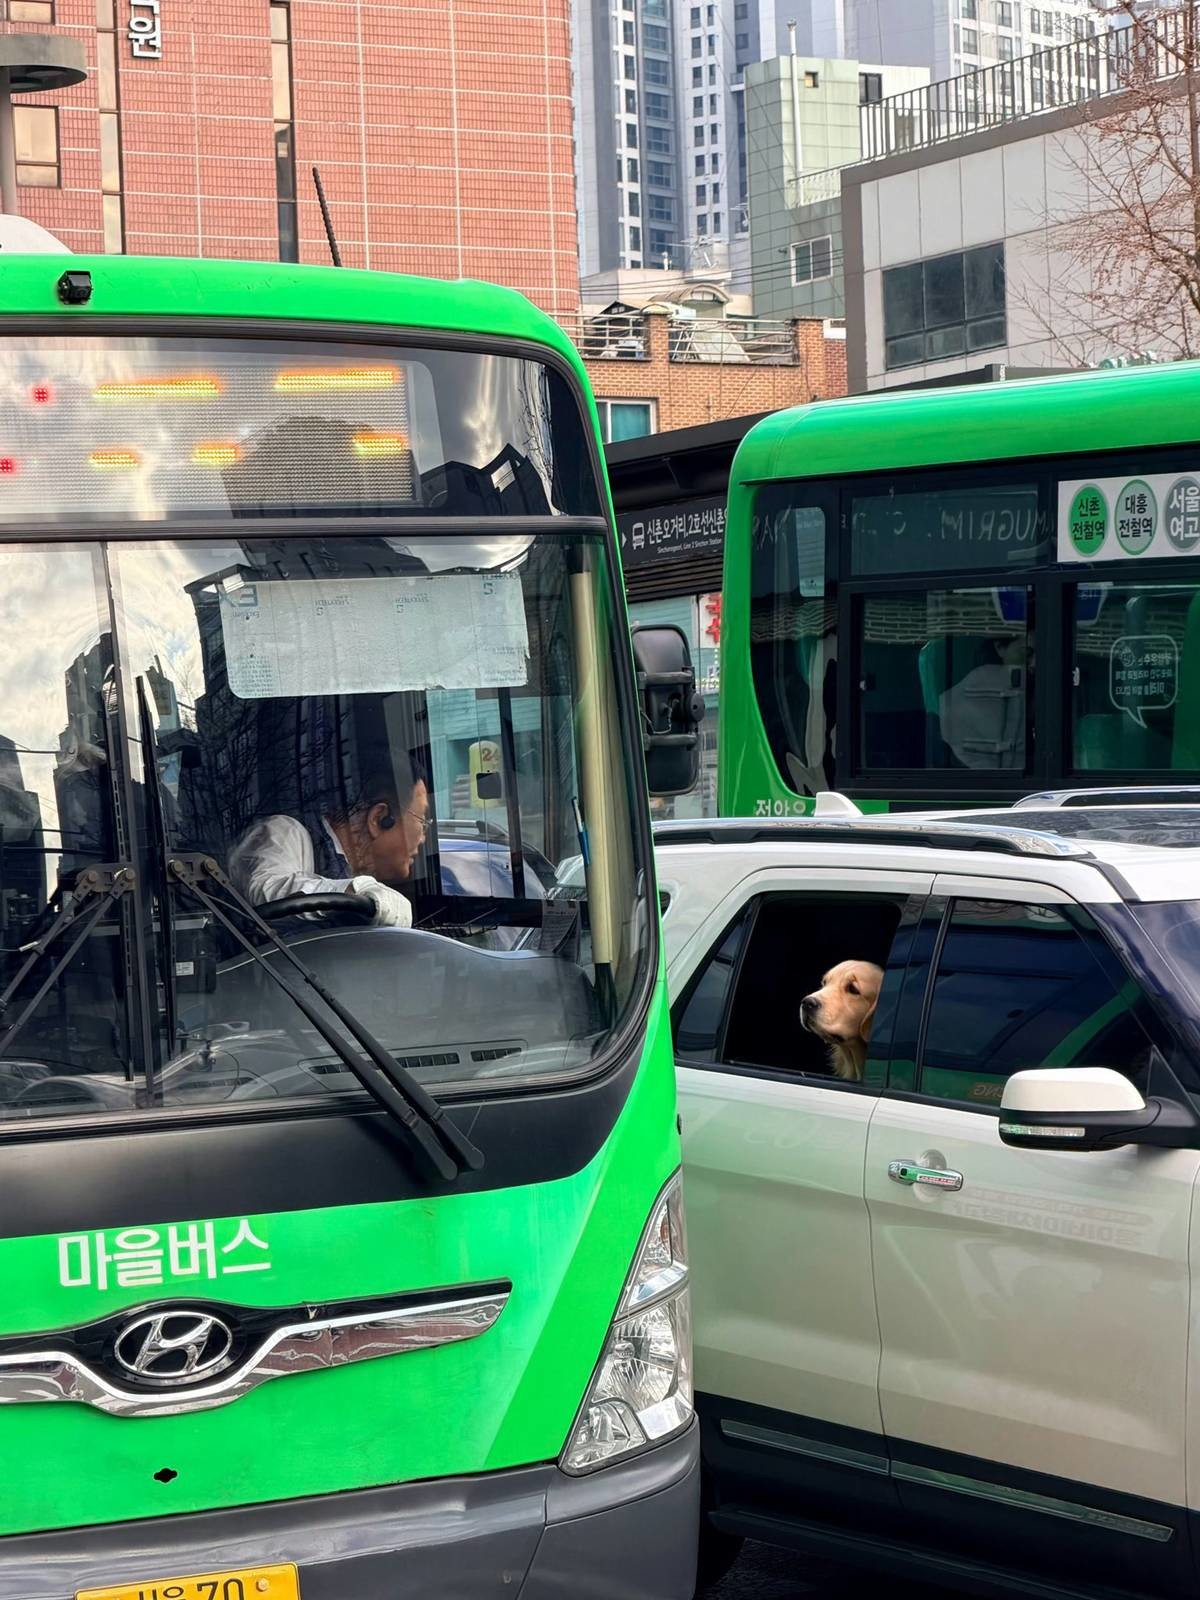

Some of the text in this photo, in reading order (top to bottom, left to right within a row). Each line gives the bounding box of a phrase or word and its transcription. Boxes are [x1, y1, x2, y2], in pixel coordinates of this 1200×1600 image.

[1078, 497, 1100, 517] 신촌
[1125, 494, 1148, 514] 대흥
[1169, 485, 1200, 513] 서울
[1072, 520, 1105, 541] 전철역
[1119, 517, 1153, 539] 전철역
[1170, 515, 1200, 541] 여고
[58, 1218, 271, 1290] 마을버스
